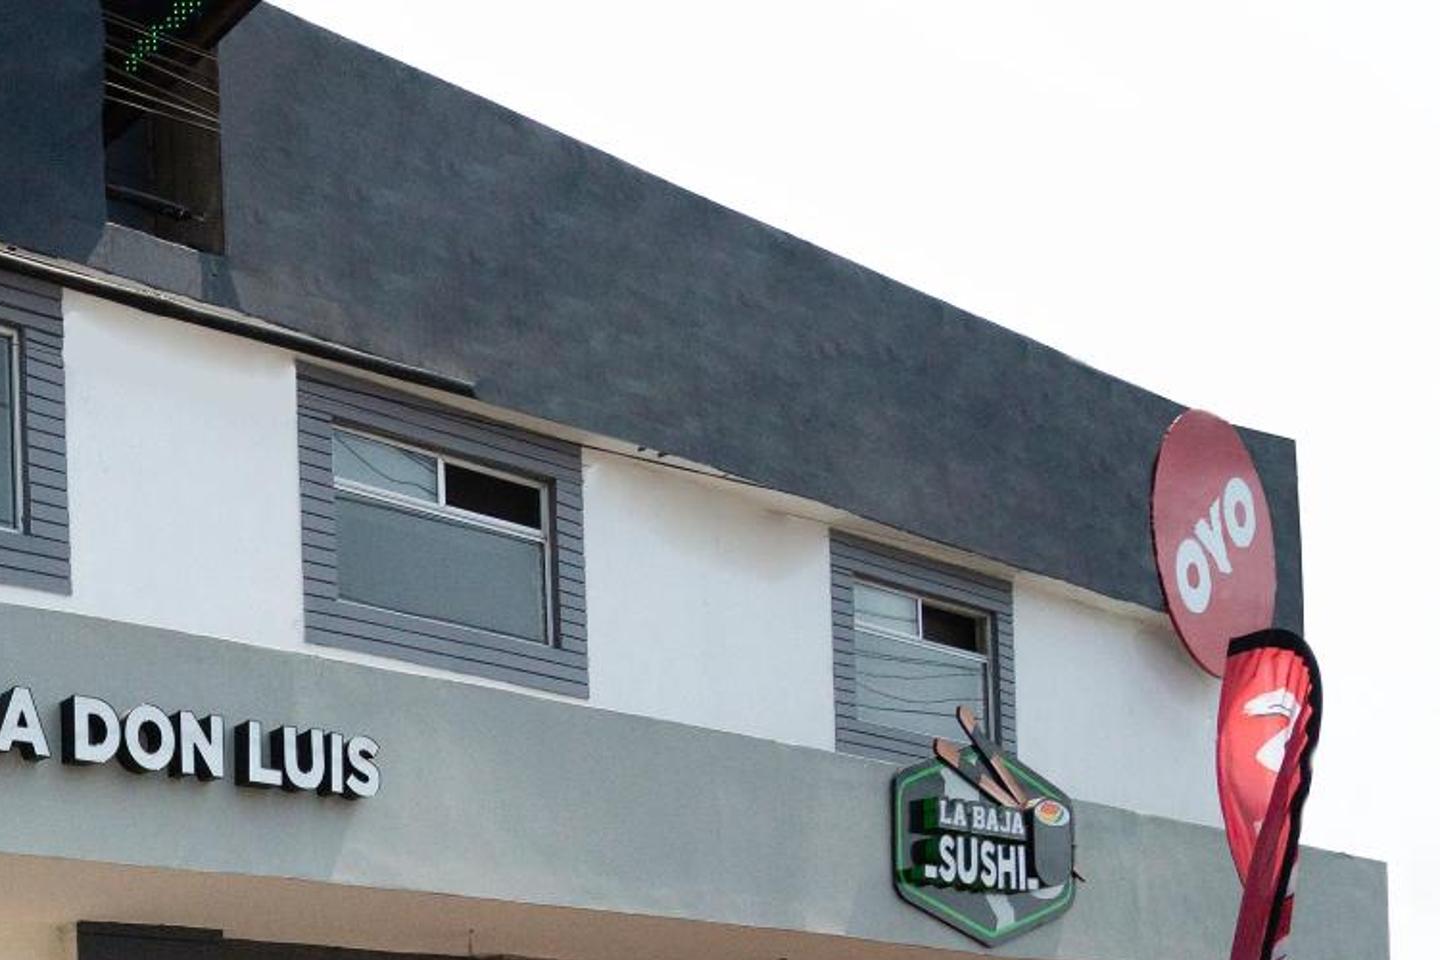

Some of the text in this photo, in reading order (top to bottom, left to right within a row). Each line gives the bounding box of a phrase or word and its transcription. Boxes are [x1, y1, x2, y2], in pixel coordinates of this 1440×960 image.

[1175, 477, 1257, 613] OYO
[61, 694, 226, 781] DON
[234, 719, 382, 799] LUIS
[939, 799, 1025, 835] LA BAJA
[939, 834, 1027, 892] SUSHI
